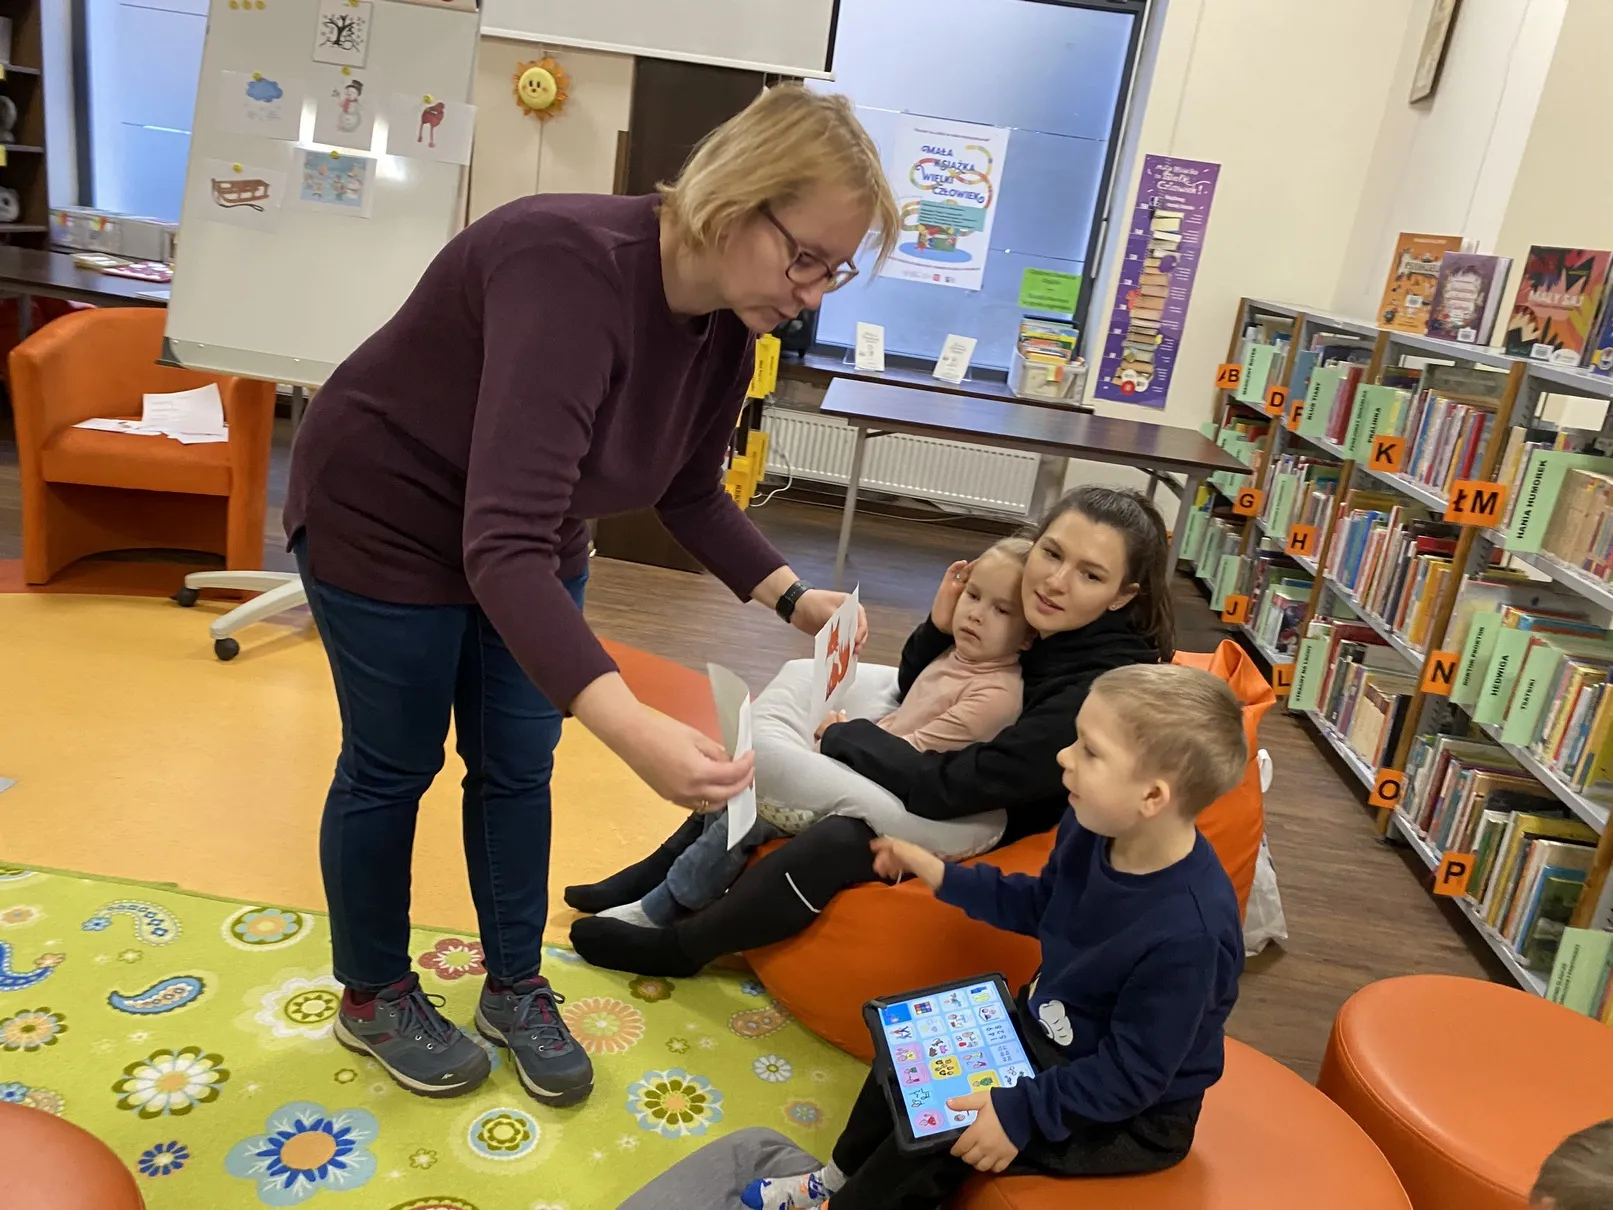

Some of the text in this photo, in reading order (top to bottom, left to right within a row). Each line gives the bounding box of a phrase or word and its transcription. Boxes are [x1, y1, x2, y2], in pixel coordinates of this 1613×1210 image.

[1270, 391, 1285, 407] D
[1375, 442, 1396, 465] K
[1239, 493, 1255, 509] G
[1516, 459, 1548, 540] HANIA HUMOREK
[1290, 532, 1308, 550] H
[1226, 601, 1239, 616] J
[1277, 670, 1291, 687] L
[1431, 660, 1456, 684] N
[1490, 654, 1510, 696] HEDWIGA
[1520, 678, 1536, 710] TSATSIKI
[1378, 779, 1400, 801] O
[1443, 860, 1466, 884] P
